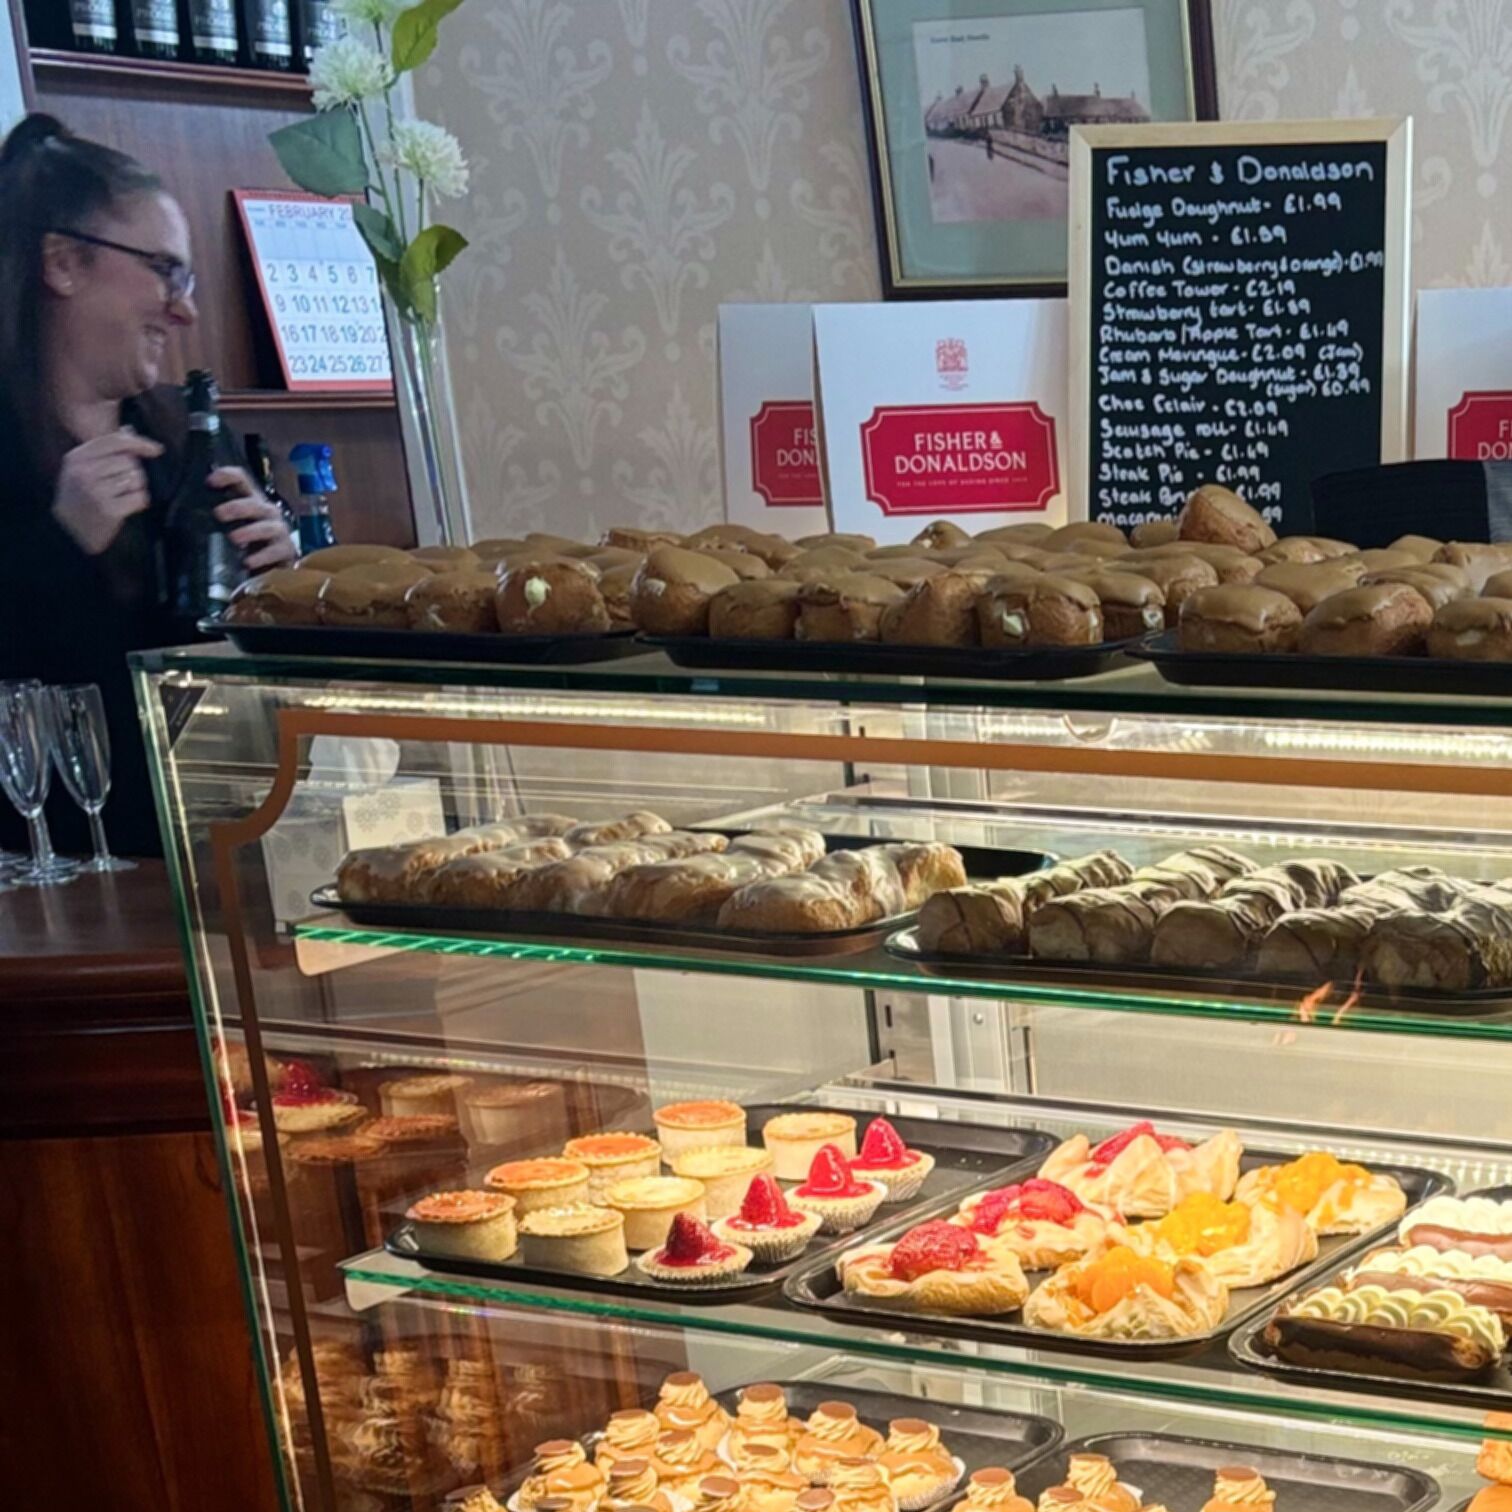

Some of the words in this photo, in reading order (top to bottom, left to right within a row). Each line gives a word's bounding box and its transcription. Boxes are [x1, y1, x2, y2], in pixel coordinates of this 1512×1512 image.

[1106, 155, 1195, 186] Fisher
[1237, 154, 1374, 185] Donaldson
[268, 204, 334, 219] FEBRUARY
[1106, 197, 1164, 228] Fudge
[1284, 192, 1342, 215] £1.99
[1104, 229, 1150, 248] Yum
[1156, 228, 1202, 247] Yum
[267, 263, 277, 282] 2
[287, 263, 299, 281] 3
[308, 265, 318, 282] 4
[328, 264, 338, 284] 5
[347, 265, 357, 284] 6
[366, 265, 374, 282] 7
[1104, 254, 1175, 276] Danish
[1103, 280, 1166, 299] Coffee
[1172, 280, 1229, 298] Tower
[1245, 278, 1296, 298] £2.19
[275, 294, 286, 313] 9
[292, 295, 310, 313] 10
[313, 296, 329, 313] 11
[333, 295, 349, 313] 12
[354, 296, 369, 314] 13
[1102, 302, 1202, 326] Strawberry
[281, 325, 299, 343] 16
[301, 324, 316, 343] 17
[320, 325, 339, 343] 18
[340, 325, 358, 343] 19
[359, 326, 377, 343] 20
[1251, 343, 1306, 363] £2.09
[289, 355, 308, 373] 23
[310, 355, 327, 373] 24
[328, 355, 347, 373] 25
[350, 355, 367, 373] 26
[369, 356, 383, 373] 27
[1098, 366, 1137, 386] Jam
[914, 432, 986, 452] FISHER
[990, 430, 1002, 450] &
[1100, 418, 1186, 447] Sausage
[1101, 441, 1166, 460] Scotch
[1174, 443, 1200, 461] Pie
[895, 451, 1027, 475] DONALDSON
[1098, 463, 1150, 482] Steak
[1158, 464, 1184, 484] Pie
[1098, 487, 1152, 508] Steak
